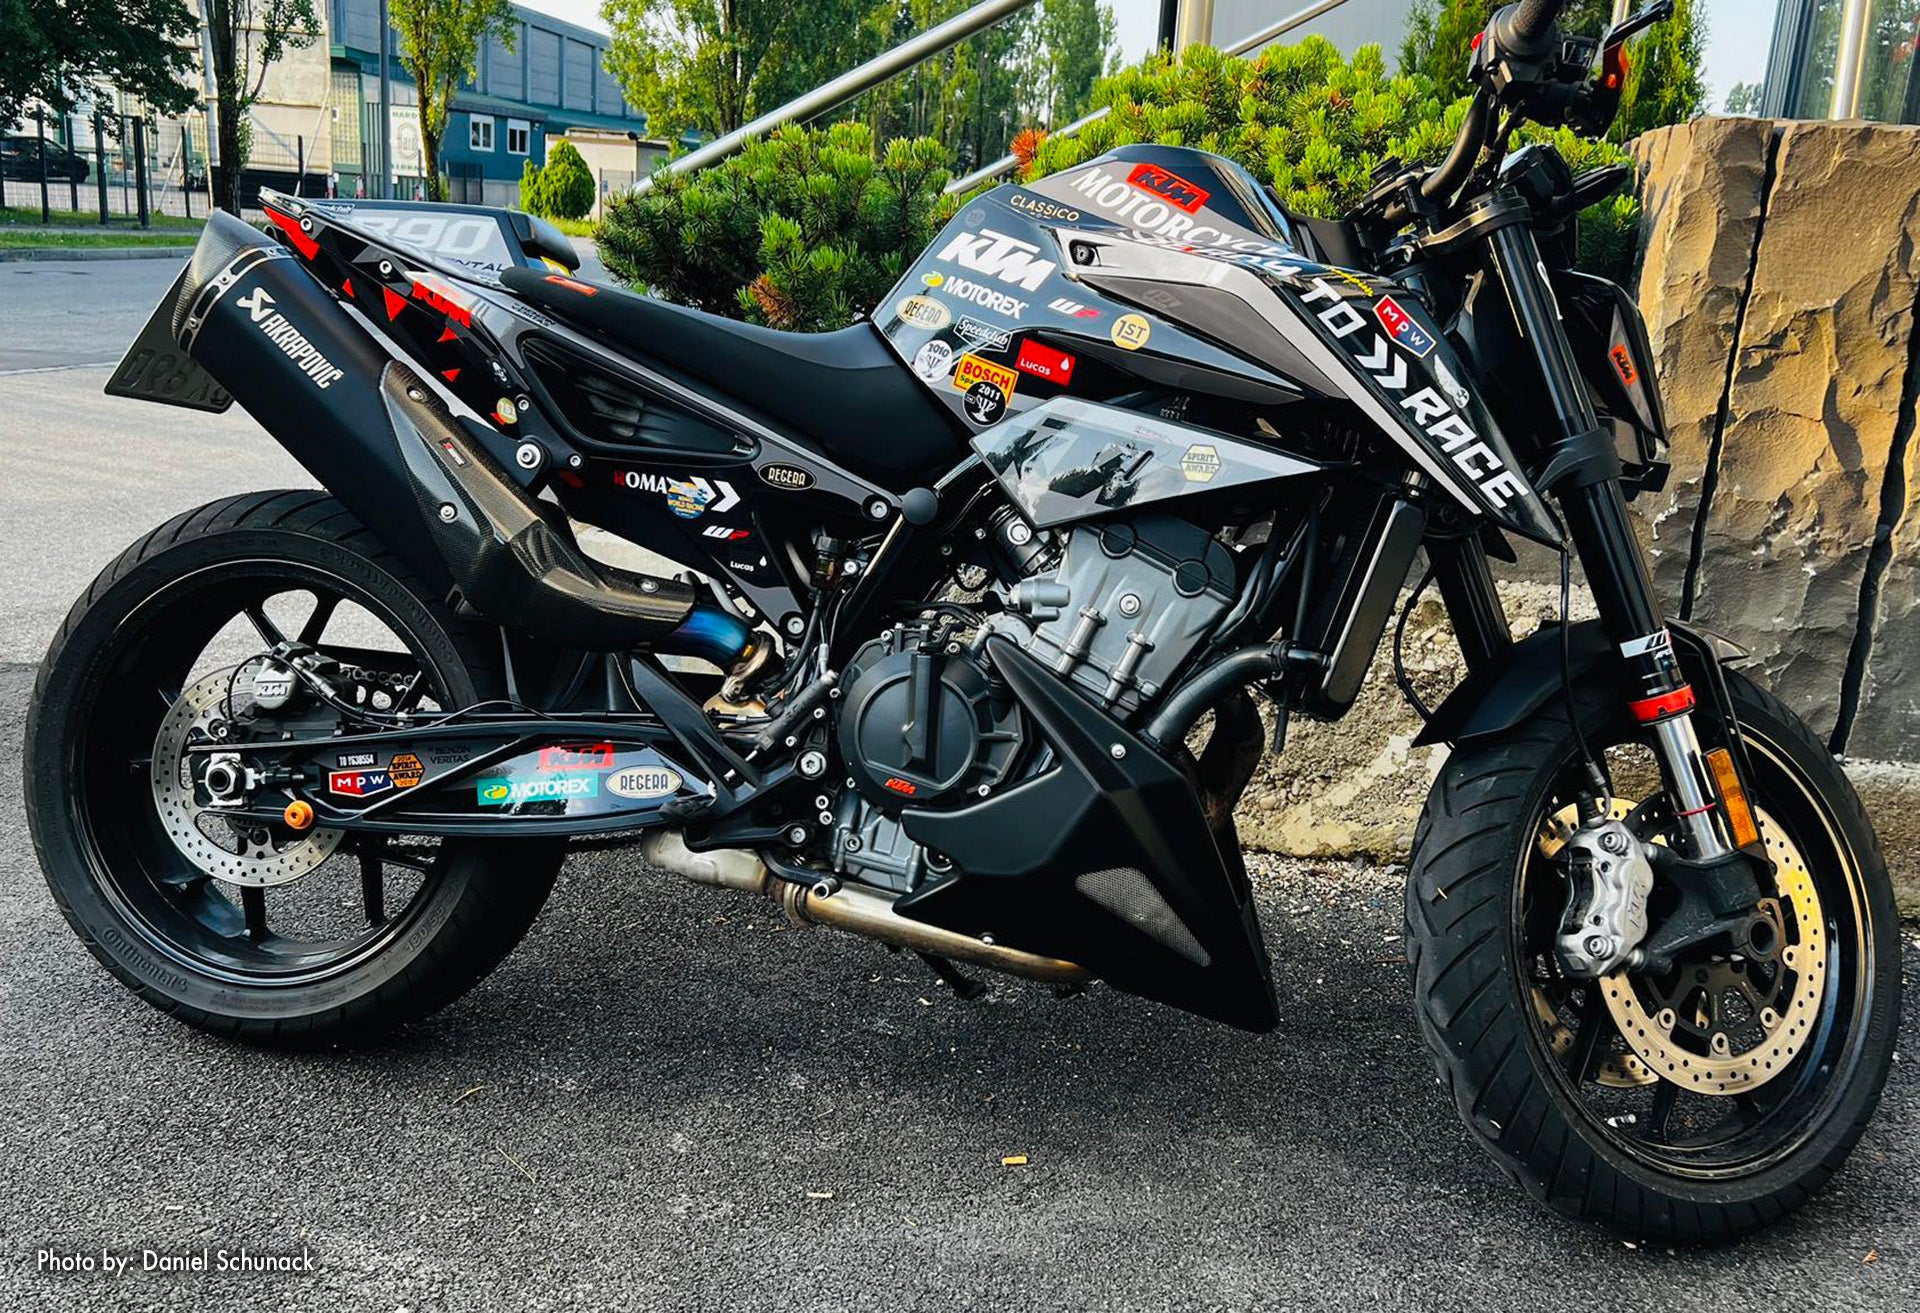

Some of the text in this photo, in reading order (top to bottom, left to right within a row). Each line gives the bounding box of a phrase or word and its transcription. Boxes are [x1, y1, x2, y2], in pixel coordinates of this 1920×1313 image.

[1137, 171, 1192, 208] KTM
[1010, 194, 1079, 222] CLASSICO
[936, 228, 1056, 292] KTM
[943, 275, 1026, 320] MOTOREX
[904, 301, 942, 324] REGERA
[1048, 298, 1100, 318] WP
[958, 319, 1009, 347] Speedclub
[1117, 320, 1148, 340] 1ST
[963, 361, 1011, 390] BOSCH
[1020, 357, 1051, 376] Lucas
[960, 374, 976, 385] Spa
[978, 383, 1001, 401] 2011
[1300, 277, 1368, 338] TO
[1400, 387, 1529, 509] RACE
[1187, 452, 1215, 463] SPIRIT
[768, 467, 806, 486] REGERA
[1185, 463, 1216, 474] AWARD
[613, 469, 667, 495] ROMA
[702, 525, 750, 540] WP
[730, 560, 754, 572] Lucas
[392, 761, 418, 770] SPIRIT
[430, 754, 471, 765] VERITAS
[393, 771, 421, 781] AWARD
[620, 774, 669, 791] REGERA
[510, 777, 590, 800] MOTOREX
[884, 777, 917, 795] KTM
[102, 926, 179, 990] Continental
